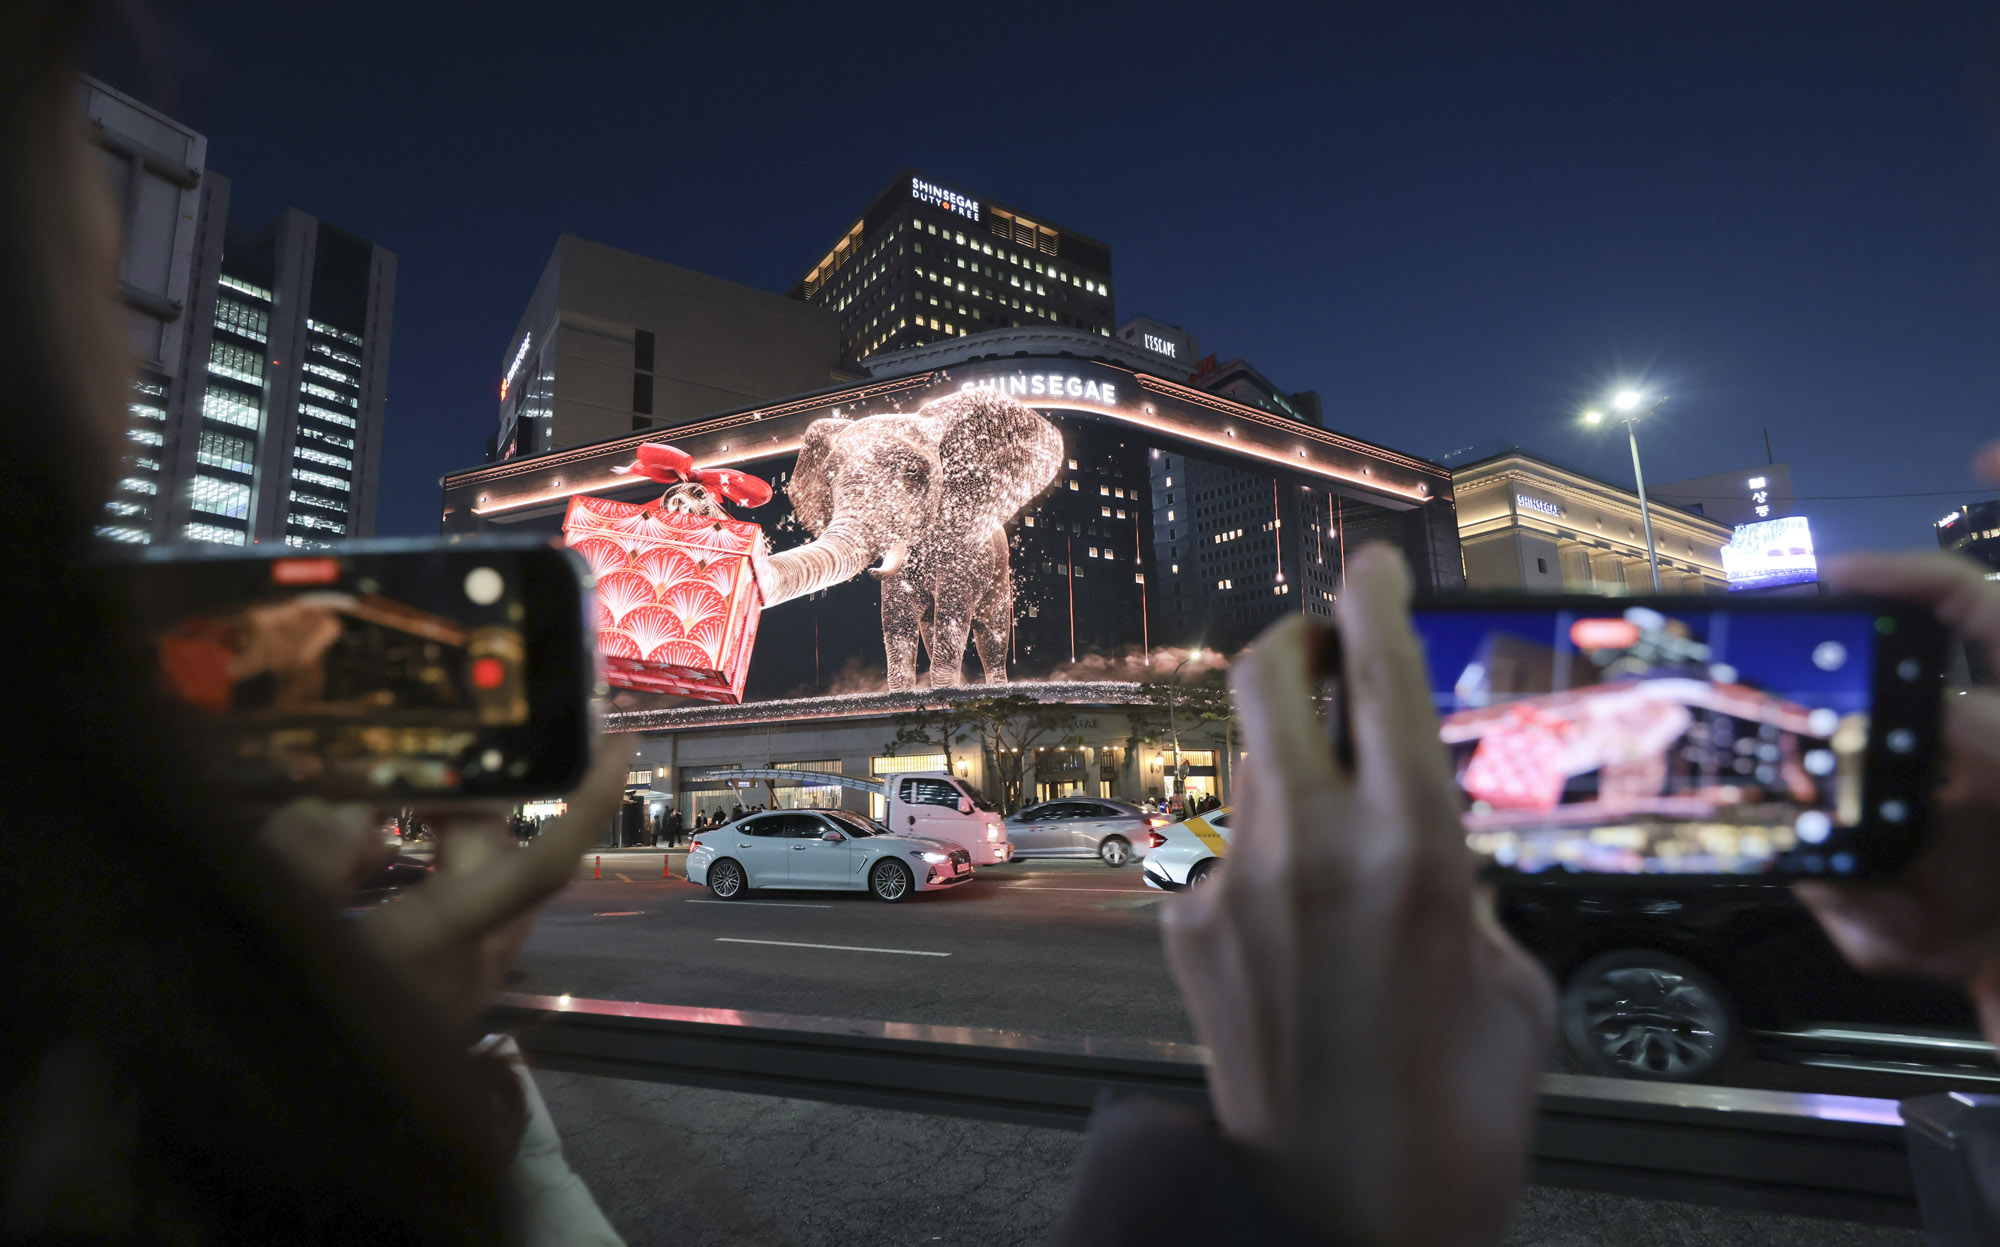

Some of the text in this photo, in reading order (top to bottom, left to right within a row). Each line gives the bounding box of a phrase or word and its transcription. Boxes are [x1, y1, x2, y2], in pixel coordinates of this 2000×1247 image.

[912, 177, 979, 212] SHINSEGAE
[912, 189, 980, 222] DUTY FREE
[1144, 333, 1176, 358] L'ESCAPE
[1516, 494, 1560, 517] SHINSEGAE
